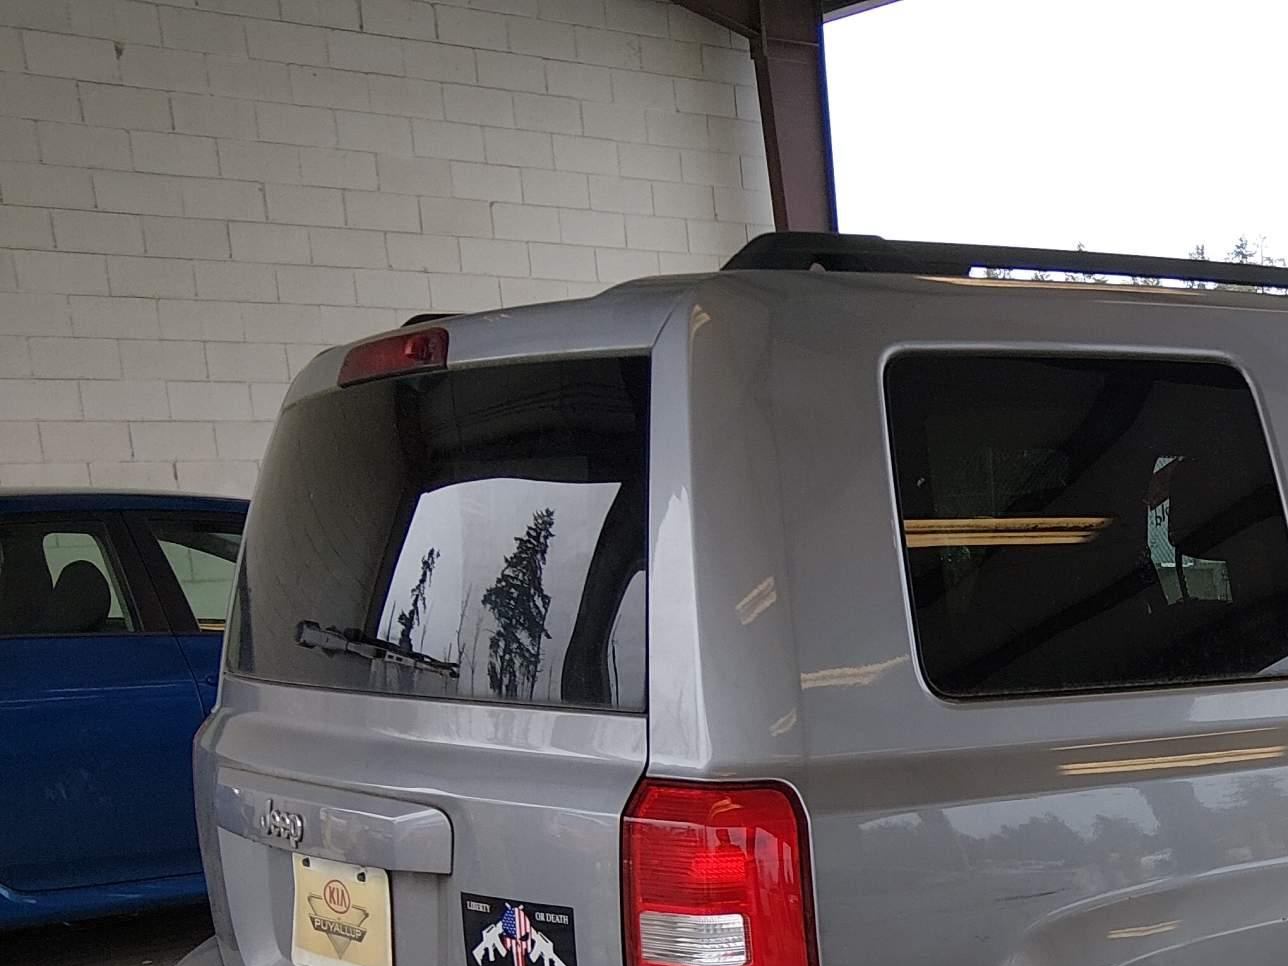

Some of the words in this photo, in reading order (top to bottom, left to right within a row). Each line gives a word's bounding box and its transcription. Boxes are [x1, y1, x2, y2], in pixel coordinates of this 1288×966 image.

[260, 799, 303, 849] Jeep
[328, 885, 347, 906] KIA
[466, 901, 491, 913] LIBERTY
[534, 911, 546, 921] OR
[546, 913, 569, 925] DEATH
[314, 918, 362, 939] PUYALLUP
